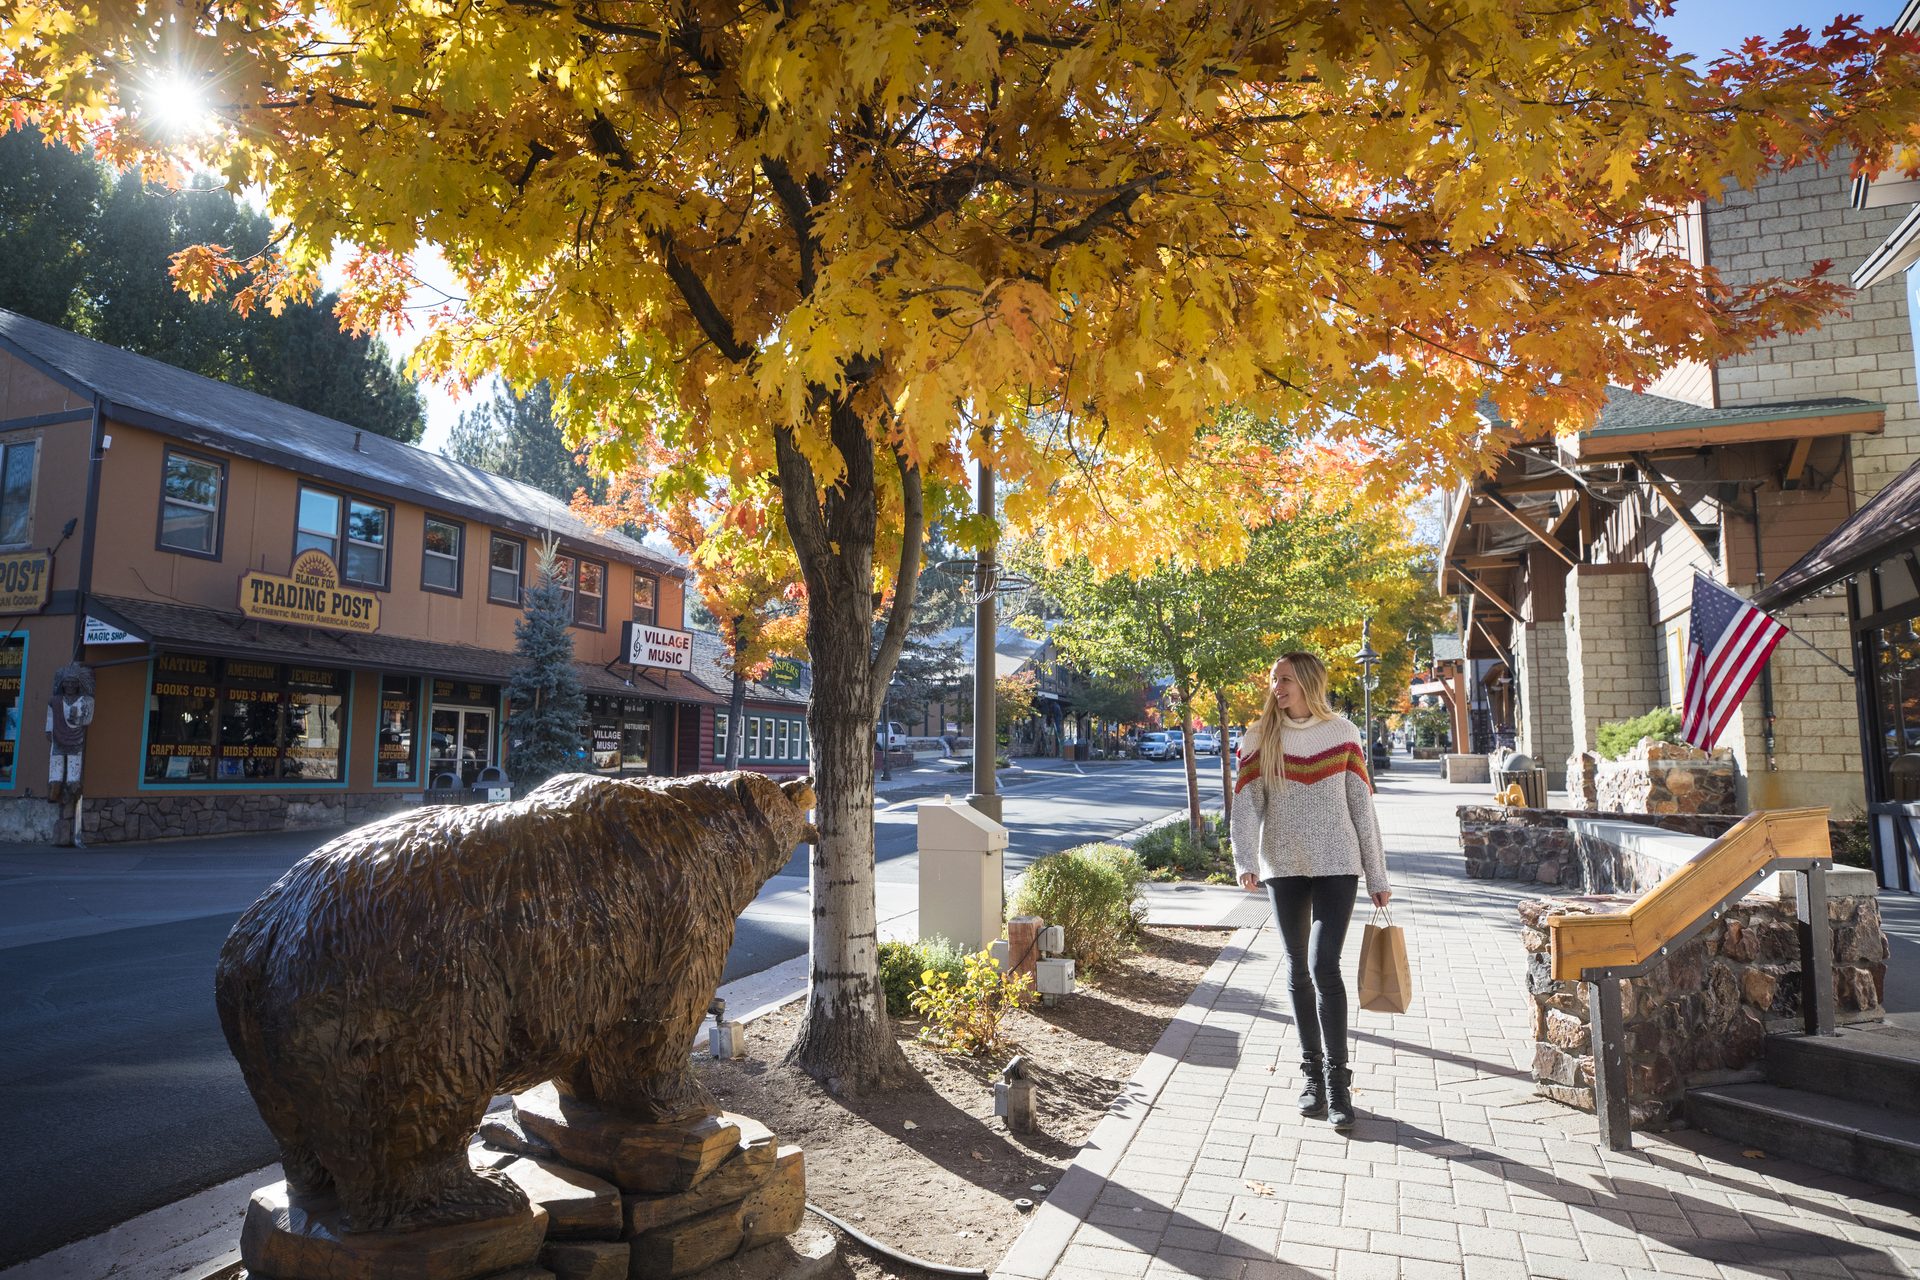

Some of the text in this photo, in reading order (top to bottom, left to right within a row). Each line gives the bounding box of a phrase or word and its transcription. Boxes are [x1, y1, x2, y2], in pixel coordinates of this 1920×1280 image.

[295, 573, 336, 590] BLACK FOX
[250, 578, 373, 620] TRADING POST
[87, 631, 127, 641] MAGIC SHOP
[645, 630, 689, 650] VILLAGE
[648, 648, 683, 665] MUSIC
[159, 655, 334, 685] NATIVE AMERICAN JEWELRY
[155, 682, 190, 696] BOOKS
[193, 685, 216, 698] CD'S
[229, 689, 257, 701] DVD'S
[260, 691, 280, 703] ART
[593, 730, 622, 740] VILLAGE
[150, 744, 175, 756] CRAFT
[177, 744, 212, 757] SUPPLIES
[223, 745, 250, 757] HIDES
[252, 745, 278, 757] SKINS
[596, 741, 618, 750] MUSIC
